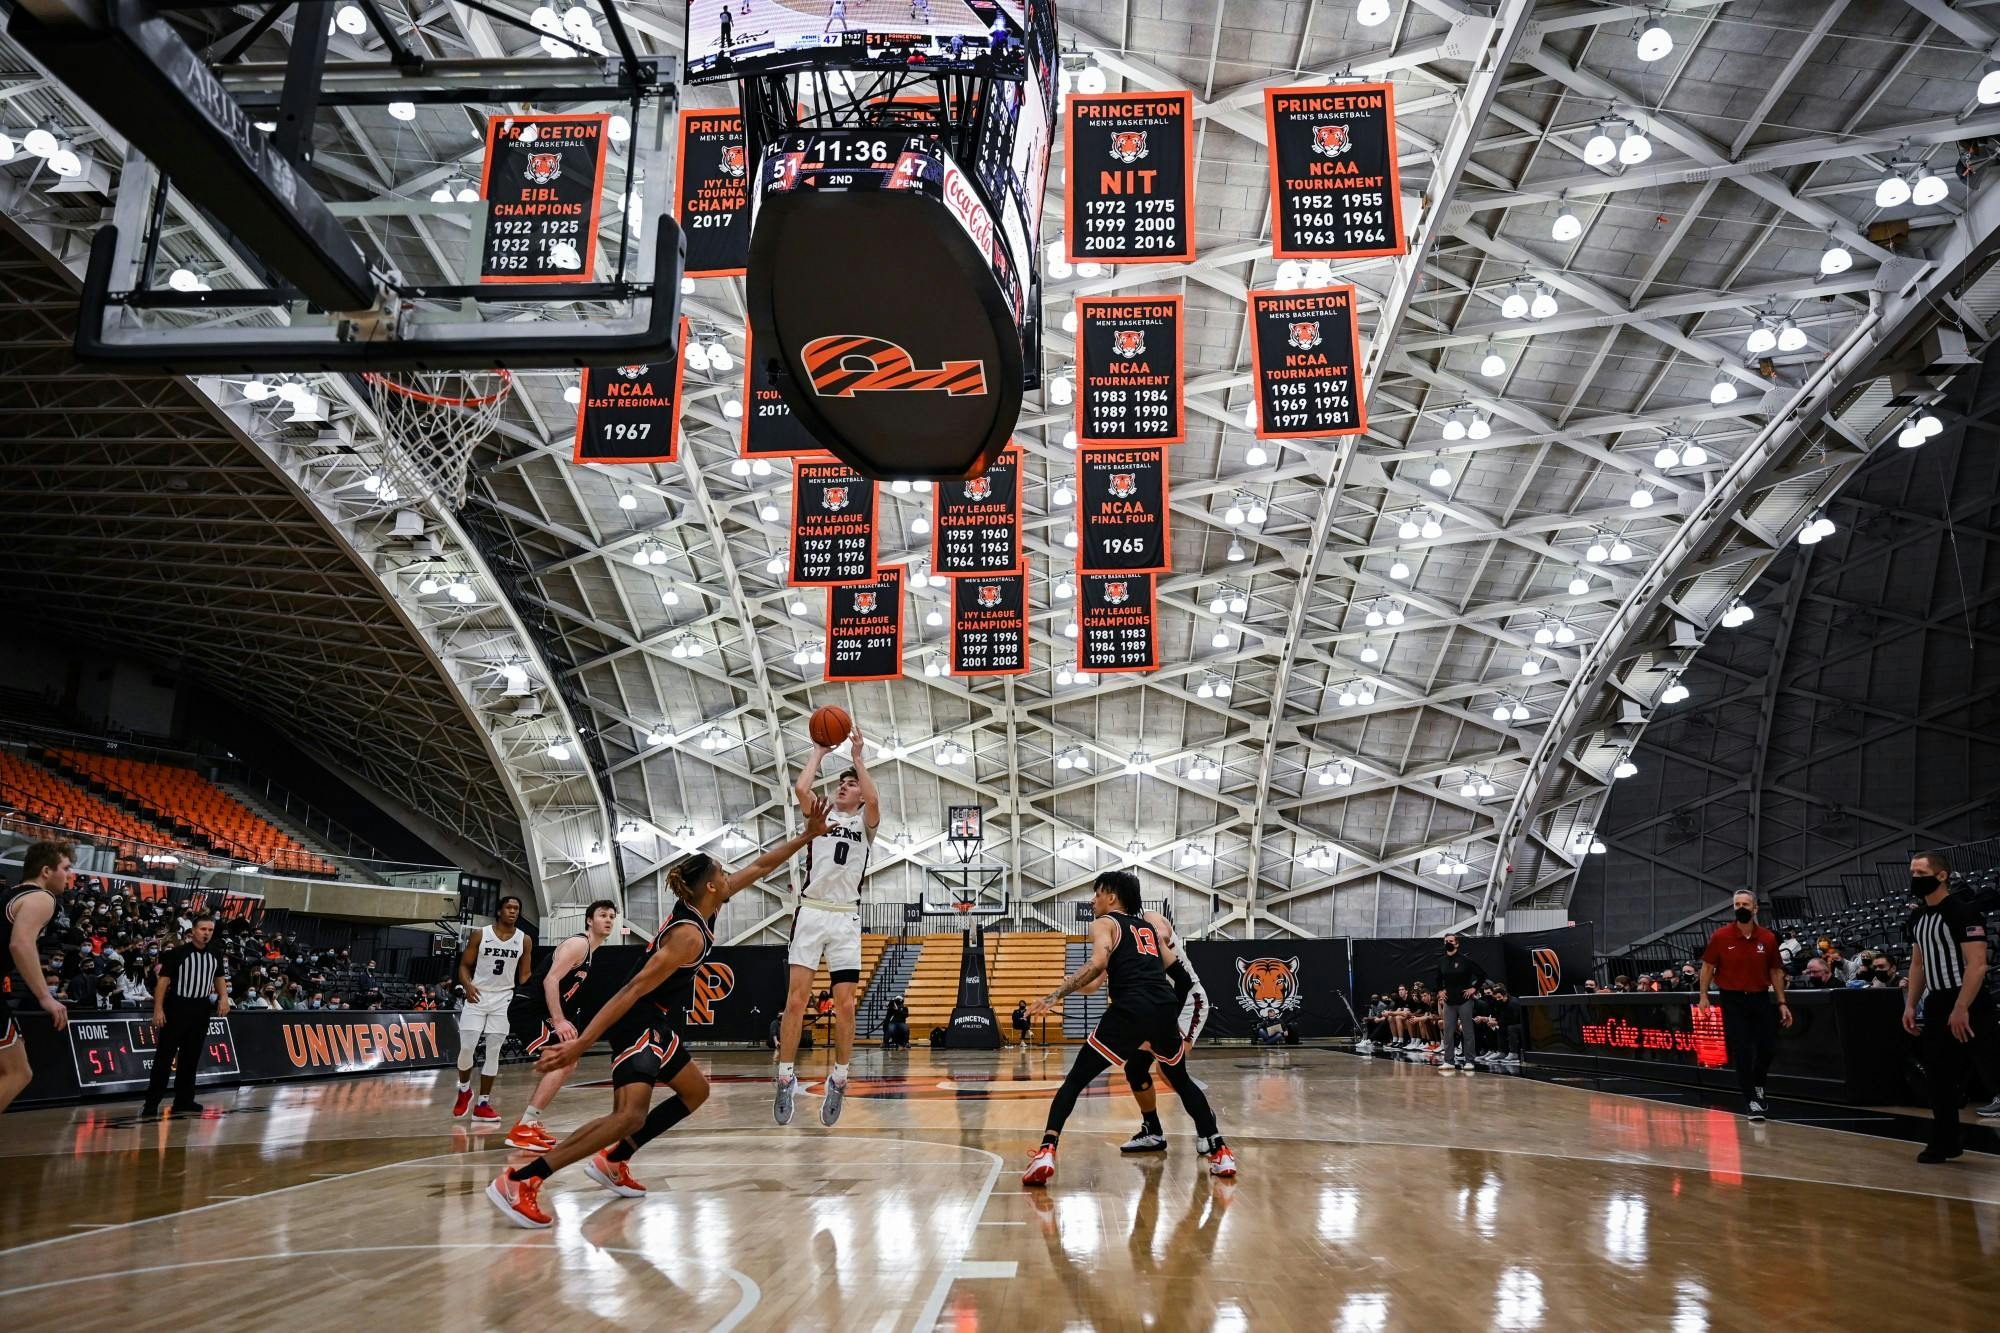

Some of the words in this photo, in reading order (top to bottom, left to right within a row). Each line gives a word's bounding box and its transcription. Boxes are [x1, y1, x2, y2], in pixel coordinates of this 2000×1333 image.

[823, 35, 838, 44] 47
[866, 35, 880, 44] 51
[1078, 102, 1180, 118] PRINCETON
[1278, 96, 1382, 112] PRINCETON
[1117, 118, 1168, 126] BASKETBALL
[1318, 112, 1370, 120] BASKETBALL
[498, 126, 598, 140] PRCETON
[768, 142, 782, 156] FL
[796, 140, 804, 150] 3
[814, 140, 887, 162] 11:36
[910, 138, 928, 152] FL
[934, 148, 942, 160] 2
[773, 157, 798, 178] 51
[900, 158, 927, 178] 47
[1310, 162, 1359, 176] NCAA
[704, 179, 722, 188] IVY
[768, 180, 786, 192] PRIN
[829, 175, 852, 184] 2ND
[896, 180, 924, 190] PENN
[1101, 170, 1157, 195] NIT
[1286, 176, 1384, 190] TOURNAMENT
[521, 188, 560, 202] EIBL
[1292, 196, 1332, 208] 1952
[1342, 193, 1382, 208] 1955
[494, 204, 582, 216] CHAMPIONS
[1086, 201, 1126, 214] 1972
[1136, 200, 1175, 213] 1975
[693, 214, 732, 228] 2017
[1294, 213, 1334, 226] 1960
[1343, 211, 1382, 226] 1961
[494, 221, 532, 234] 1922
[541, 220, 579, 234] 1925
[1086, 218, 1126, 232] 1999
[1134, 218, 1176, 232] 2000
[1294, 231, 1334, 244] 1963
[1344, 229, 1386, 244] 1964
[492, 238, 530, 252] 1932
[1085, 236, 1126, 250] 2002
[1134, 236, 1176, 249] 2016
[490, 256, 528, 270] 1952
[1258, 296, 1346, 312] PRINCETON
[1086, 306, 1173, 319] PRINCETON
[1292, 310, 1338, 318] BASKETBALL
[1286, 354, 1328, 366] NCAA
[1110, 362, 1150, 374] NCAA
[1266, 366, 1348, 380] TOURNAMENT
[1090, 376, 1170, 386] TOURNAMENT
[608, 383, 654, 396] NCAA
[1272, 383, 1306, 396] 1965
[1314, 380, 1348, 394] 1967
[1093, 391, 1126, 402] 1983
[1134, 390, 1168, 402] 1984
[588, 398, 615, 408] EAST
[618, 398, 670, 407] REGIONAL
[1273, 399, 1307, 412] 1969
[1315, 396, 1349, 408] 1976
[1093, 406, 1126, 418] 1989
[1134, 406, 1168, 417] 1990
[1274, 414, 1308, 426] 1977
[1316, 412, 1348, 424] 1981
[604, 424, 650, 440] 1967
[1093, 422, 1126, 433] 1991
[1134, 421, 1168, 432] 1992
[1086, 452, 1160, 463] PRINCETON
[949, 506, 964, 514] IVY
[968, 504, 1006, 513] LEAGUE
[1102, 501, 1144, 514] NCAA
[807, 516, 822, 524] IVY
[825, 514, 862, 523] LEAGUE
[940, 514, 1014, 526] CHAMPIONS
[1092, 515, 1122, 524] FINAL
[1126, 514, 1154, 523] FOUR
[798, 524, 870, 536] CHAMPIONS
[947, 530, 974, 540] 1959
[982, 528, 1008, 539] 1960
[804, 540, 832, 550] 1967
[838, 538, 865, 548] 1968
[946, 543, 974, 553] 1961
[981, 542, 1008, 552] 1963
[1103, 538, 1144, 554] 1965
[804, 553, 830, 564] 1969
[838, 552, 864, 562] 1976
[946, 556, 974, 566] 1964
[981, 556, 1008, 566] 1965
[803, 566, 830, 576] 1977
[837, 565, 864, 575] 1980
[981, 610, 1015, 618] LEAGUE
[1108, 606, 1142, 614] LEAGUE
[856, 616, 889, 624] LEAGUE
[958, 620, 1022, 630] CHAMPIONS
[1084, 616, 1150, 626] CHAMPIONS
[833, 626, 896, 636] CHAMPIONS
[963, 634, 988, 642] 1992
[994, 632, 1018, 642] 1996
[1090, 630, 1114, 639] 1981
[1120, 629, 1146, 638] 1983
[837, 640, 862, 648] 2004
[868, 638, 891, 648] 2011
[963, 646, 988, 654] 1997
[994, 644, 1018, 654] 1998
[1090, 642, 1115, 652] 1984
[1121, 641, 1146, 650] 1989
[836, 652, 861, 660] 2017
[962, 658, 987, 666] 2001
[993, 656, 1018, 666] 2002
[1090, 654, 1116, 664] 1990
[1121, 653, 1146, 662] 1991
[821, 826, 862, 842] ENN
[834, 841, 850, 865] 0
[907, 910, 920, 918] 101
[1080, 908, 1092, 916] 104
[1130, 925, 1158, 957] 13
[484, 948, 519, 958] PENN
[492, 960, 505, 976] 3
[954, 1016, 990, 1026] PRINCETON
[78, 1024, 110, 1040] HOME
[1582, 1025, 1606, 1044] NEW
[1608, 1018, 1639, 1048] Coke
[1642, 1028, 1674, 1050] ZERO
[283, 1022, 440, 1068] UNIVERSITY
[89, 1050, 116, 1074] 51
[210, 1043, 231, 1064] 47
